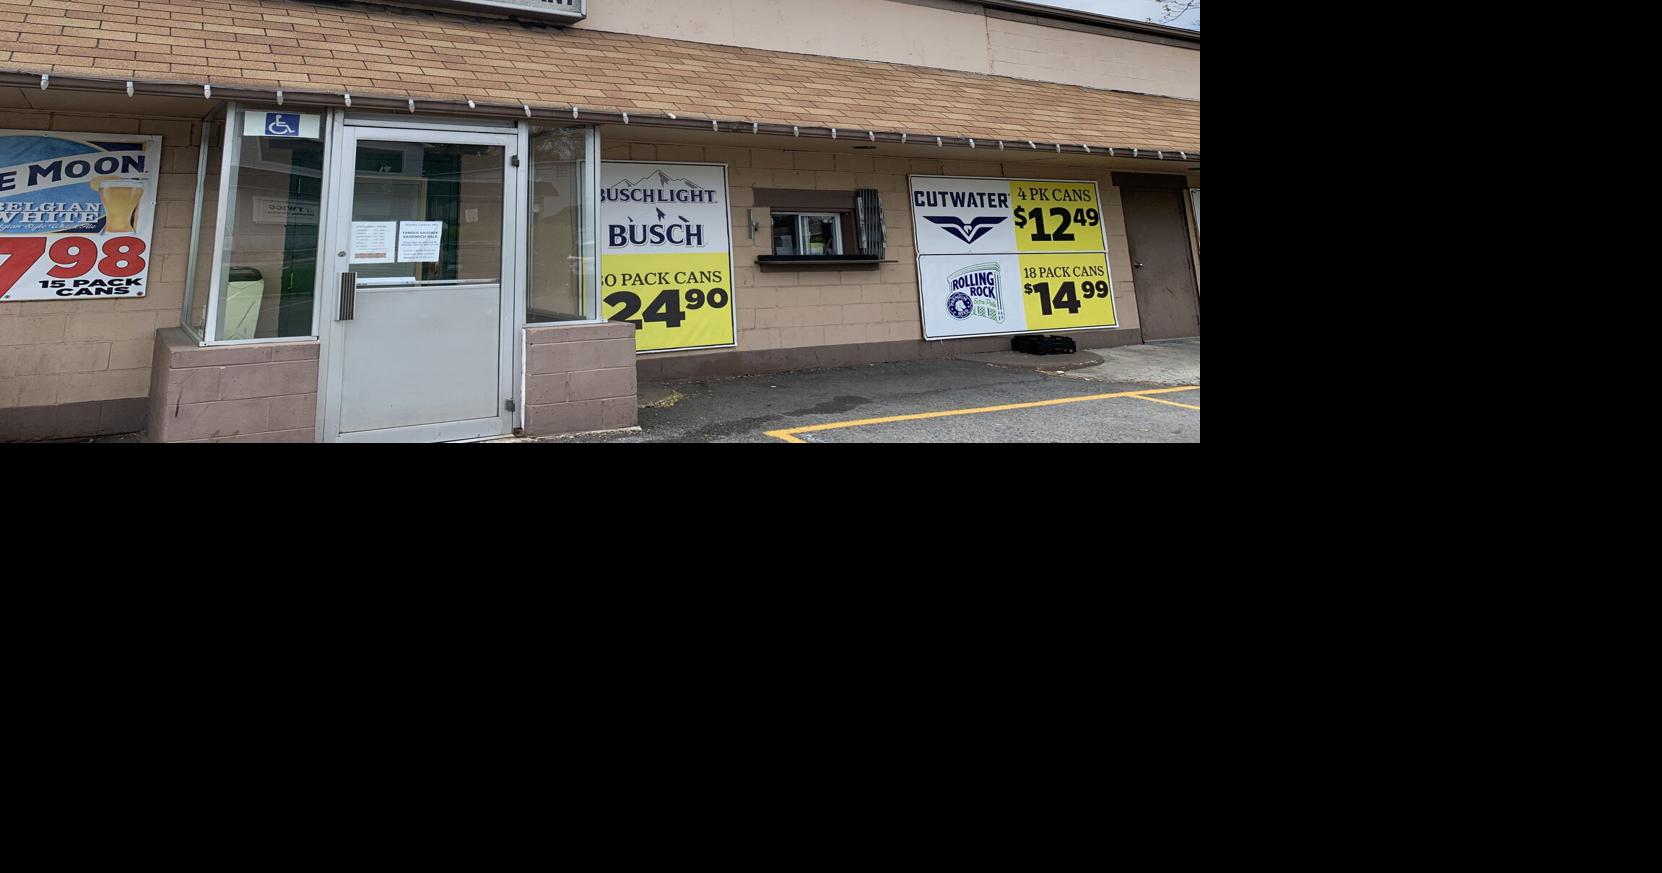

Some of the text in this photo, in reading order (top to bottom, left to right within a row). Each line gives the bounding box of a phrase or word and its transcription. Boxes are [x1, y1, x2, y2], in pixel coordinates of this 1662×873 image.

[28, 155, 145, 187] MOON
[657, 189, 716, 203] LIGHT
[914, 190, 1009, 208] CUTWATER
[1017, 187, 1091, 202] 4 PK CANS
[608, 224, 704, 247] BUSCH
[621, 272, 671, 286] PACK
[674, 271, 722, 284] CANS
[1023, 266, 1105, 278] 18 PACK CANS
[38, 278, 143, 289] 15 PACK
[952, 272, 994, 291] ROLLING
[56, 287, 130, 297] CANS
[970, 286, 996, 299] ROCK
